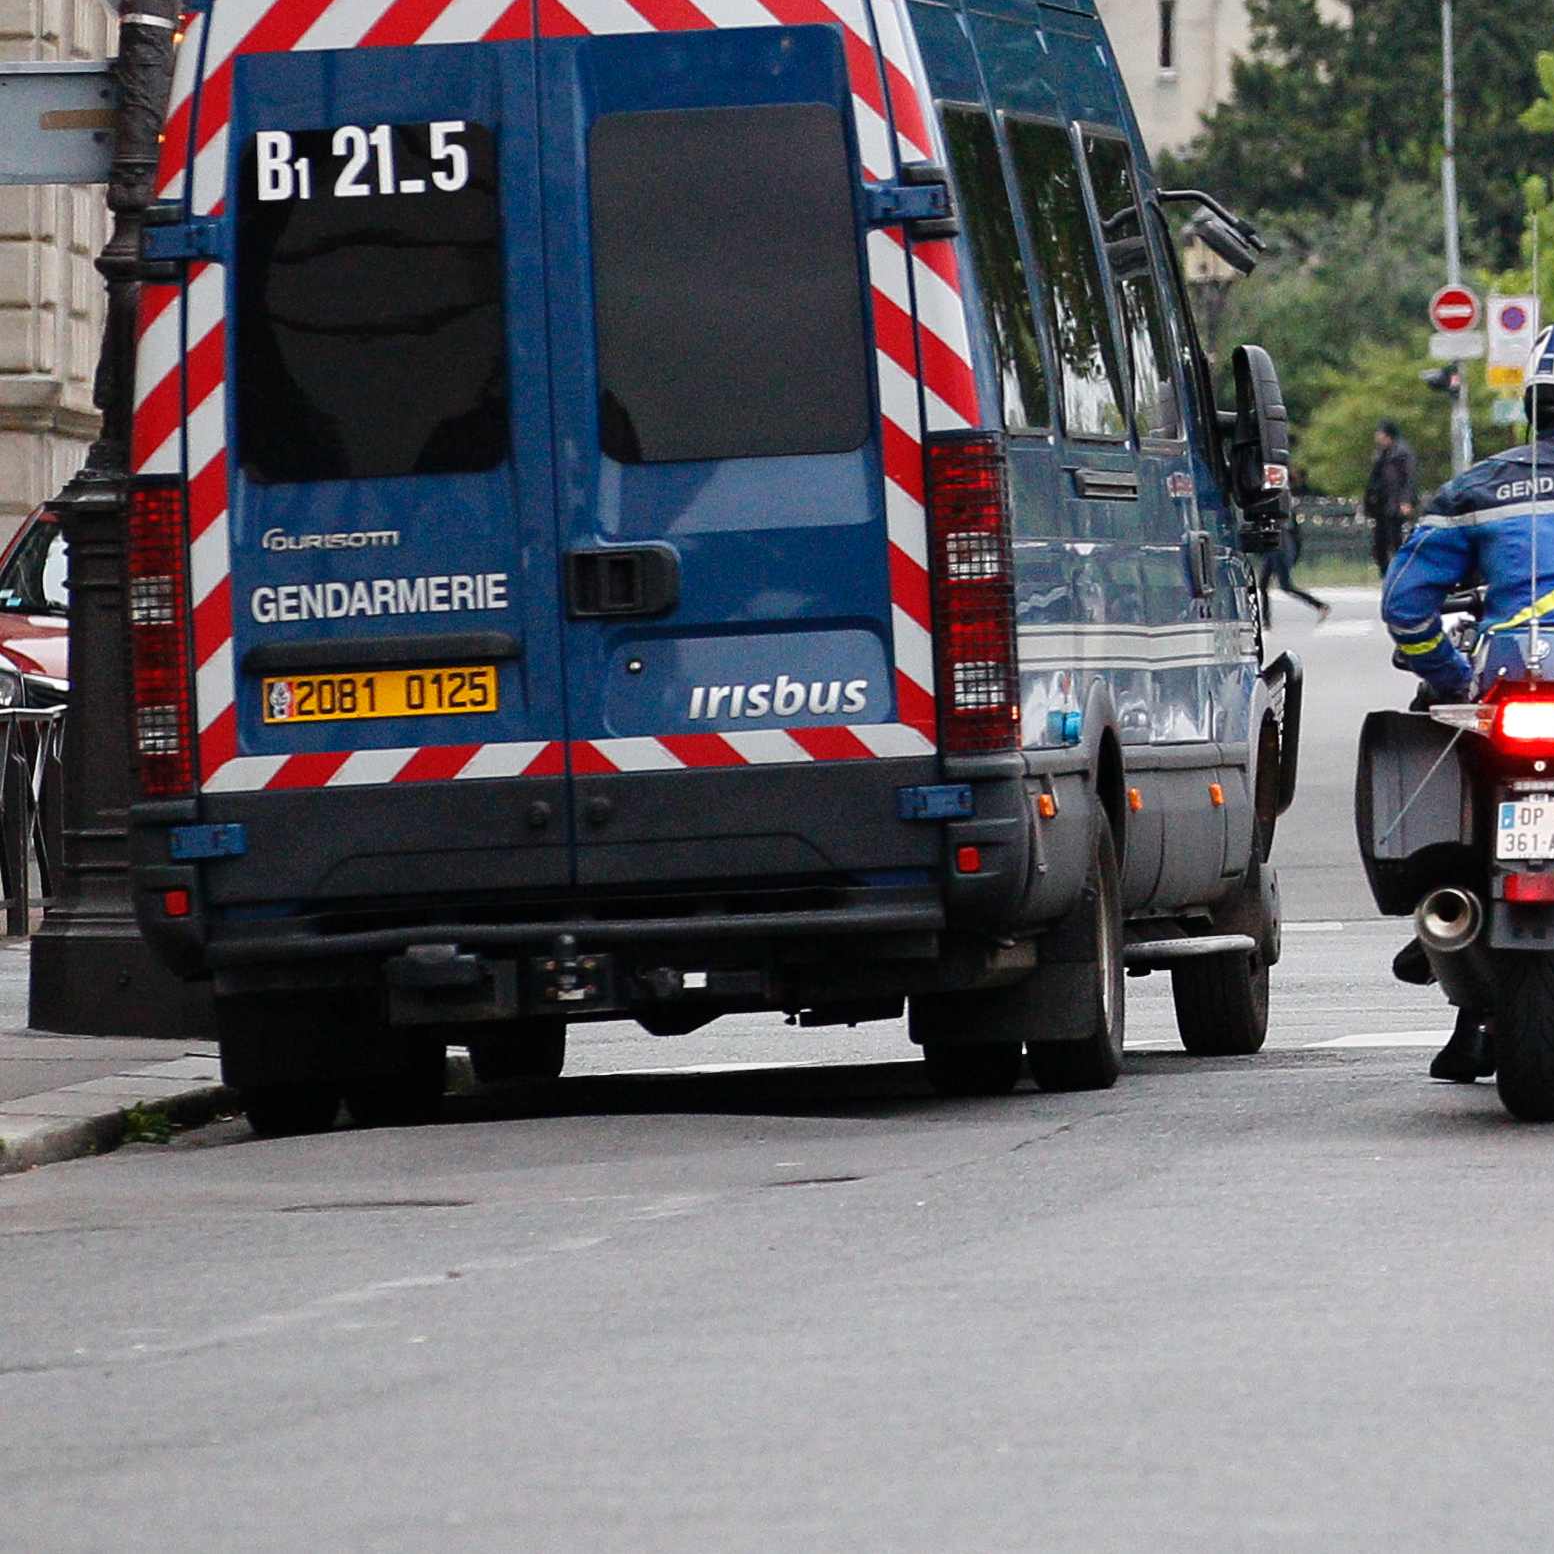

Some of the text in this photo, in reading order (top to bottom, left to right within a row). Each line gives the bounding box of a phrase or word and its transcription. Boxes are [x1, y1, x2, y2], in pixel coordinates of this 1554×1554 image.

[251, 573, 509, 623] GENDARMERIE
[296, 671, 489, 716] 2081 0125
